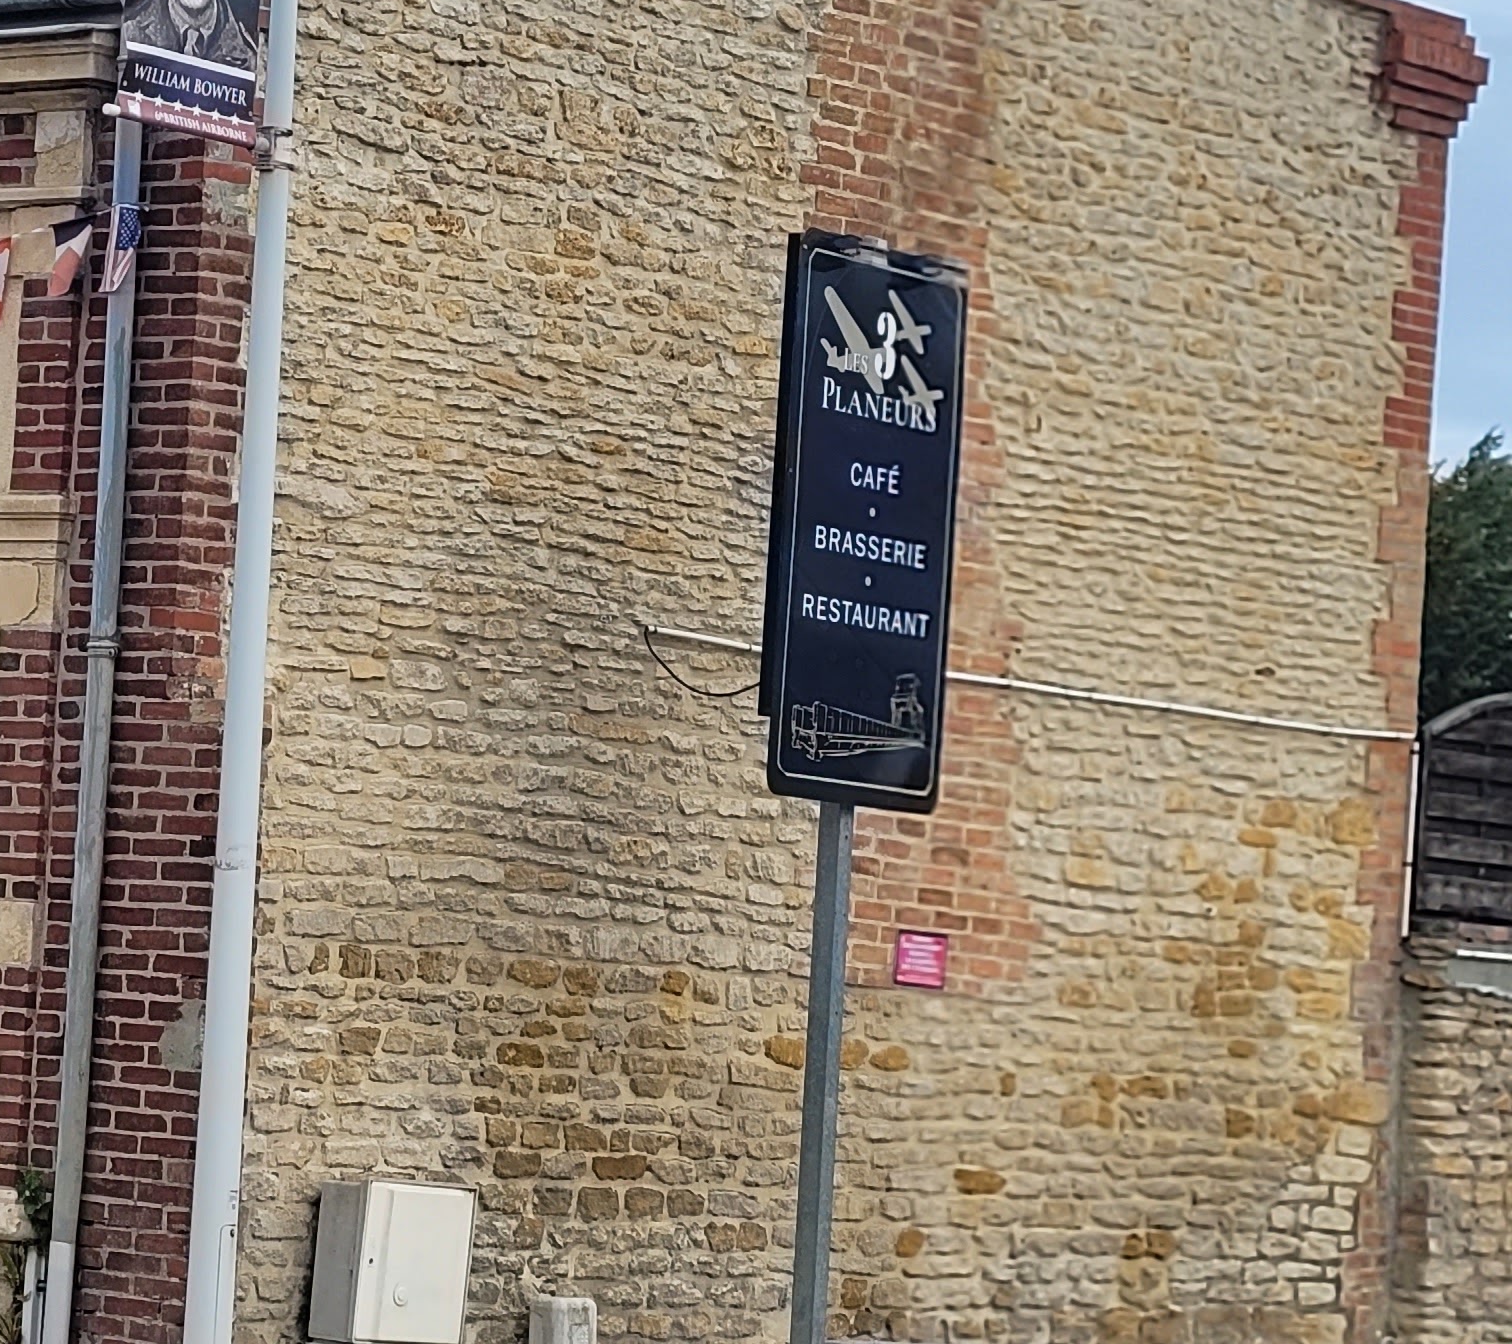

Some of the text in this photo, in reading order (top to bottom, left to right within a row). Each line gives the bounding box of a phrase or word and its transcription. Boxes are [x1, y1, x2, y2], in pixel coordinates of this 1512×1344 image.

[134, 63, 248, 107] WILLIAM BOWYER
[164, 112, 201, 131] BRITISH
[201, 122, 248, 141] AIRBORNE
[843, 311, 897, 380] LES 3
[821, 376, 937, 433] PLANEURS
[850, 462, 901, 495] CAFÉ
[814, 524, 928, 570] BRASSERIE
[802, 593, 931, 638] RESTAURANT
